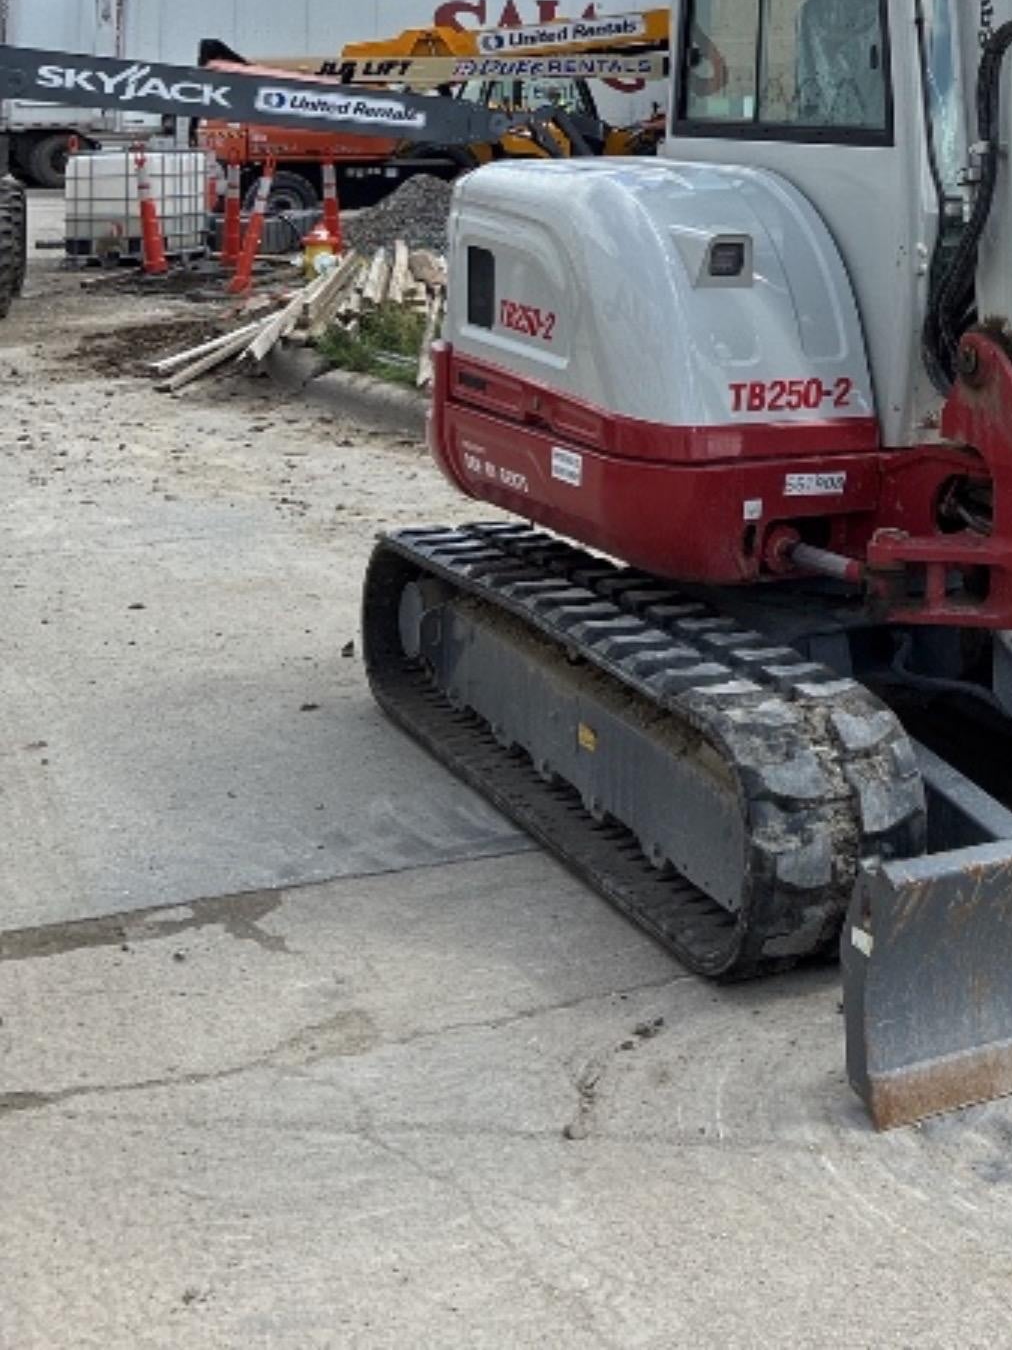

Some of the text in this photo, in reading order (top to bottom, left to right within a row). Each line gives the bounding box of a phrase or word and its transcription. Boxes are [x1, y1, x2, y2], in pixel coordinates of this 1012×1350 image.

[508, 18, 637, 47] United Rentals
[361, 59, 414, 76] LIFT
[547, 57, 653, 76] RENTALS
[35, 62, 232, 108] SKYJACK
[289, 95, 418, 122] United Rentals
[728, 376, 853, 413] TB250-2
